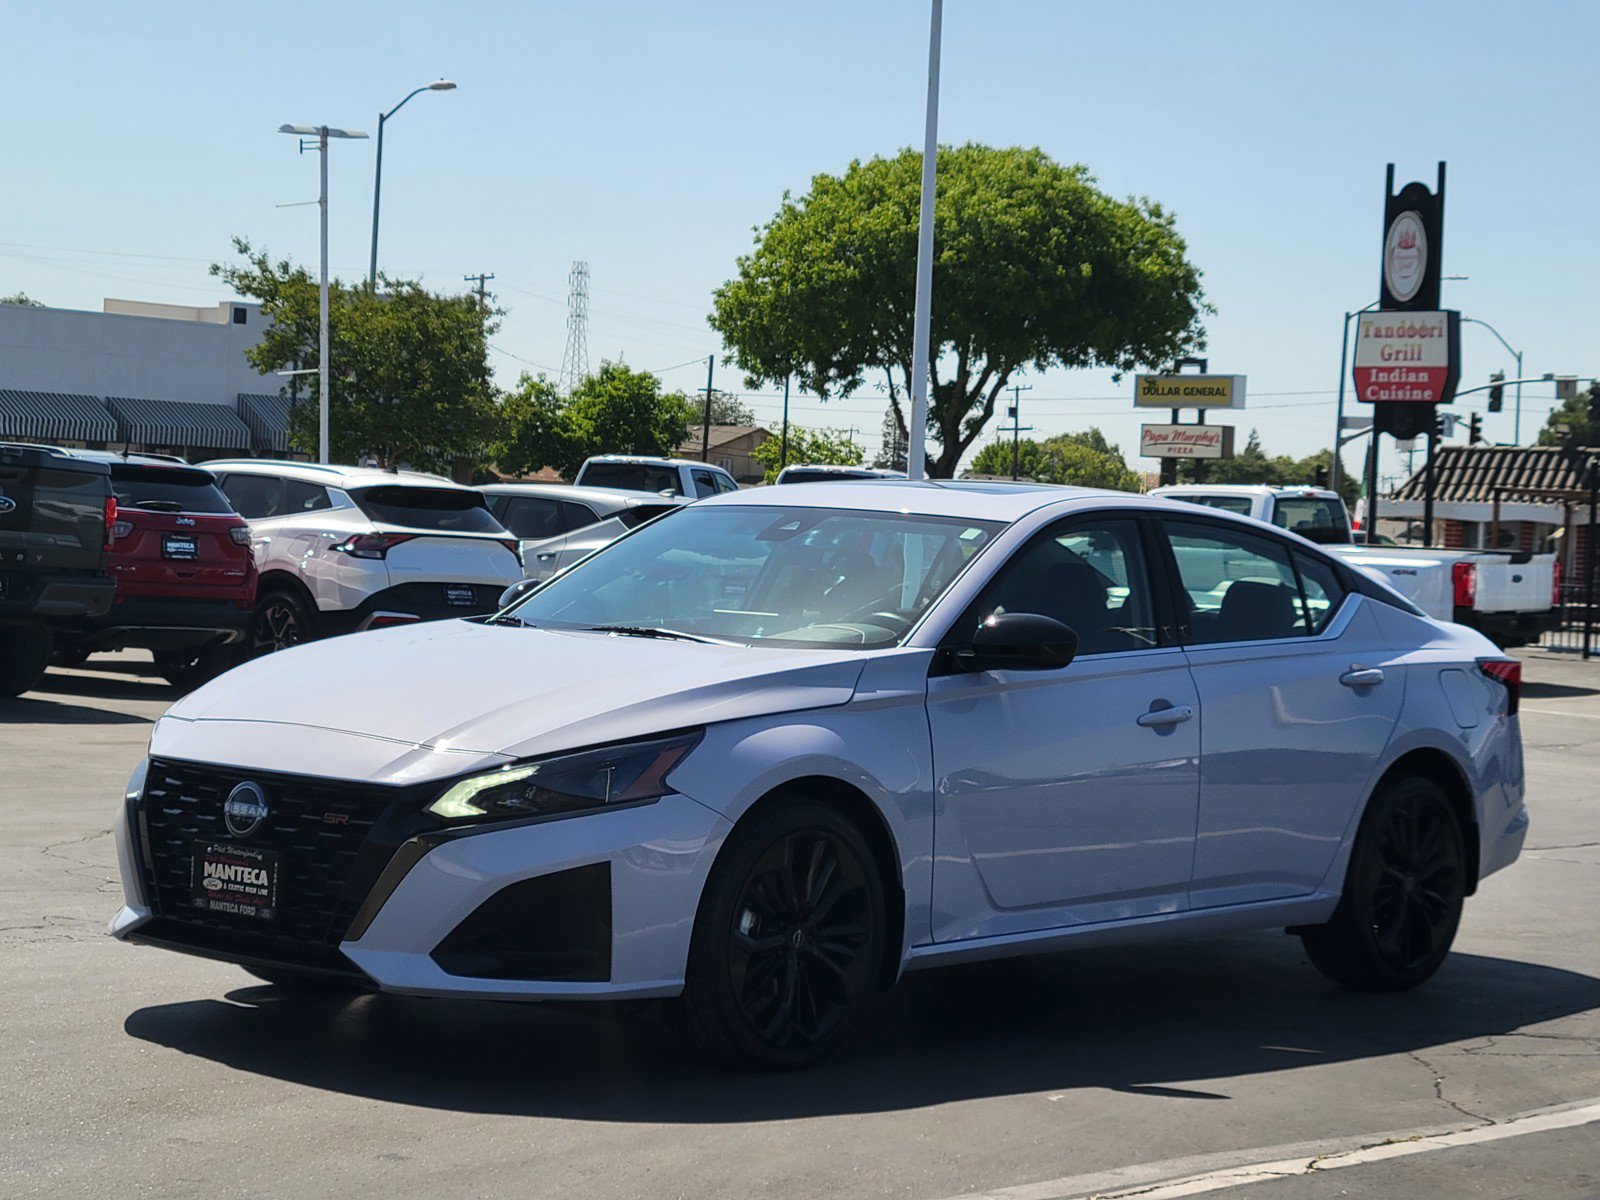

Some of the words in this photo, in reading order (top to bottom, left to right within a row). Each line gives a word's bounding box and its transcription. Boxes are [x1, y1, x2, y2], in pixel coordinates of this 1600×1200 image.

[1362, 320, 1444, 339] Tandoori
[1380, 343, 1422, 361] Grill
[1369, 368, 1429, 383] Indian
[1142, 386, 1180, 396] DOLLAR
[1183, 386, 1227, 396] GENERAL
[1366, 385, 1433, 400] Cuisine
[1142, 429, 1169, 442] Papa
[1172, 428, 1220, 445] Murphy's
[224, 802, 268, 818] NISSAN
[323, 812, 349, 826] SR
[203, 861, 269, 887] MANTECA
[209, 899, 239, 913] MANTECA
[239, 904, 256, 916] FORD
